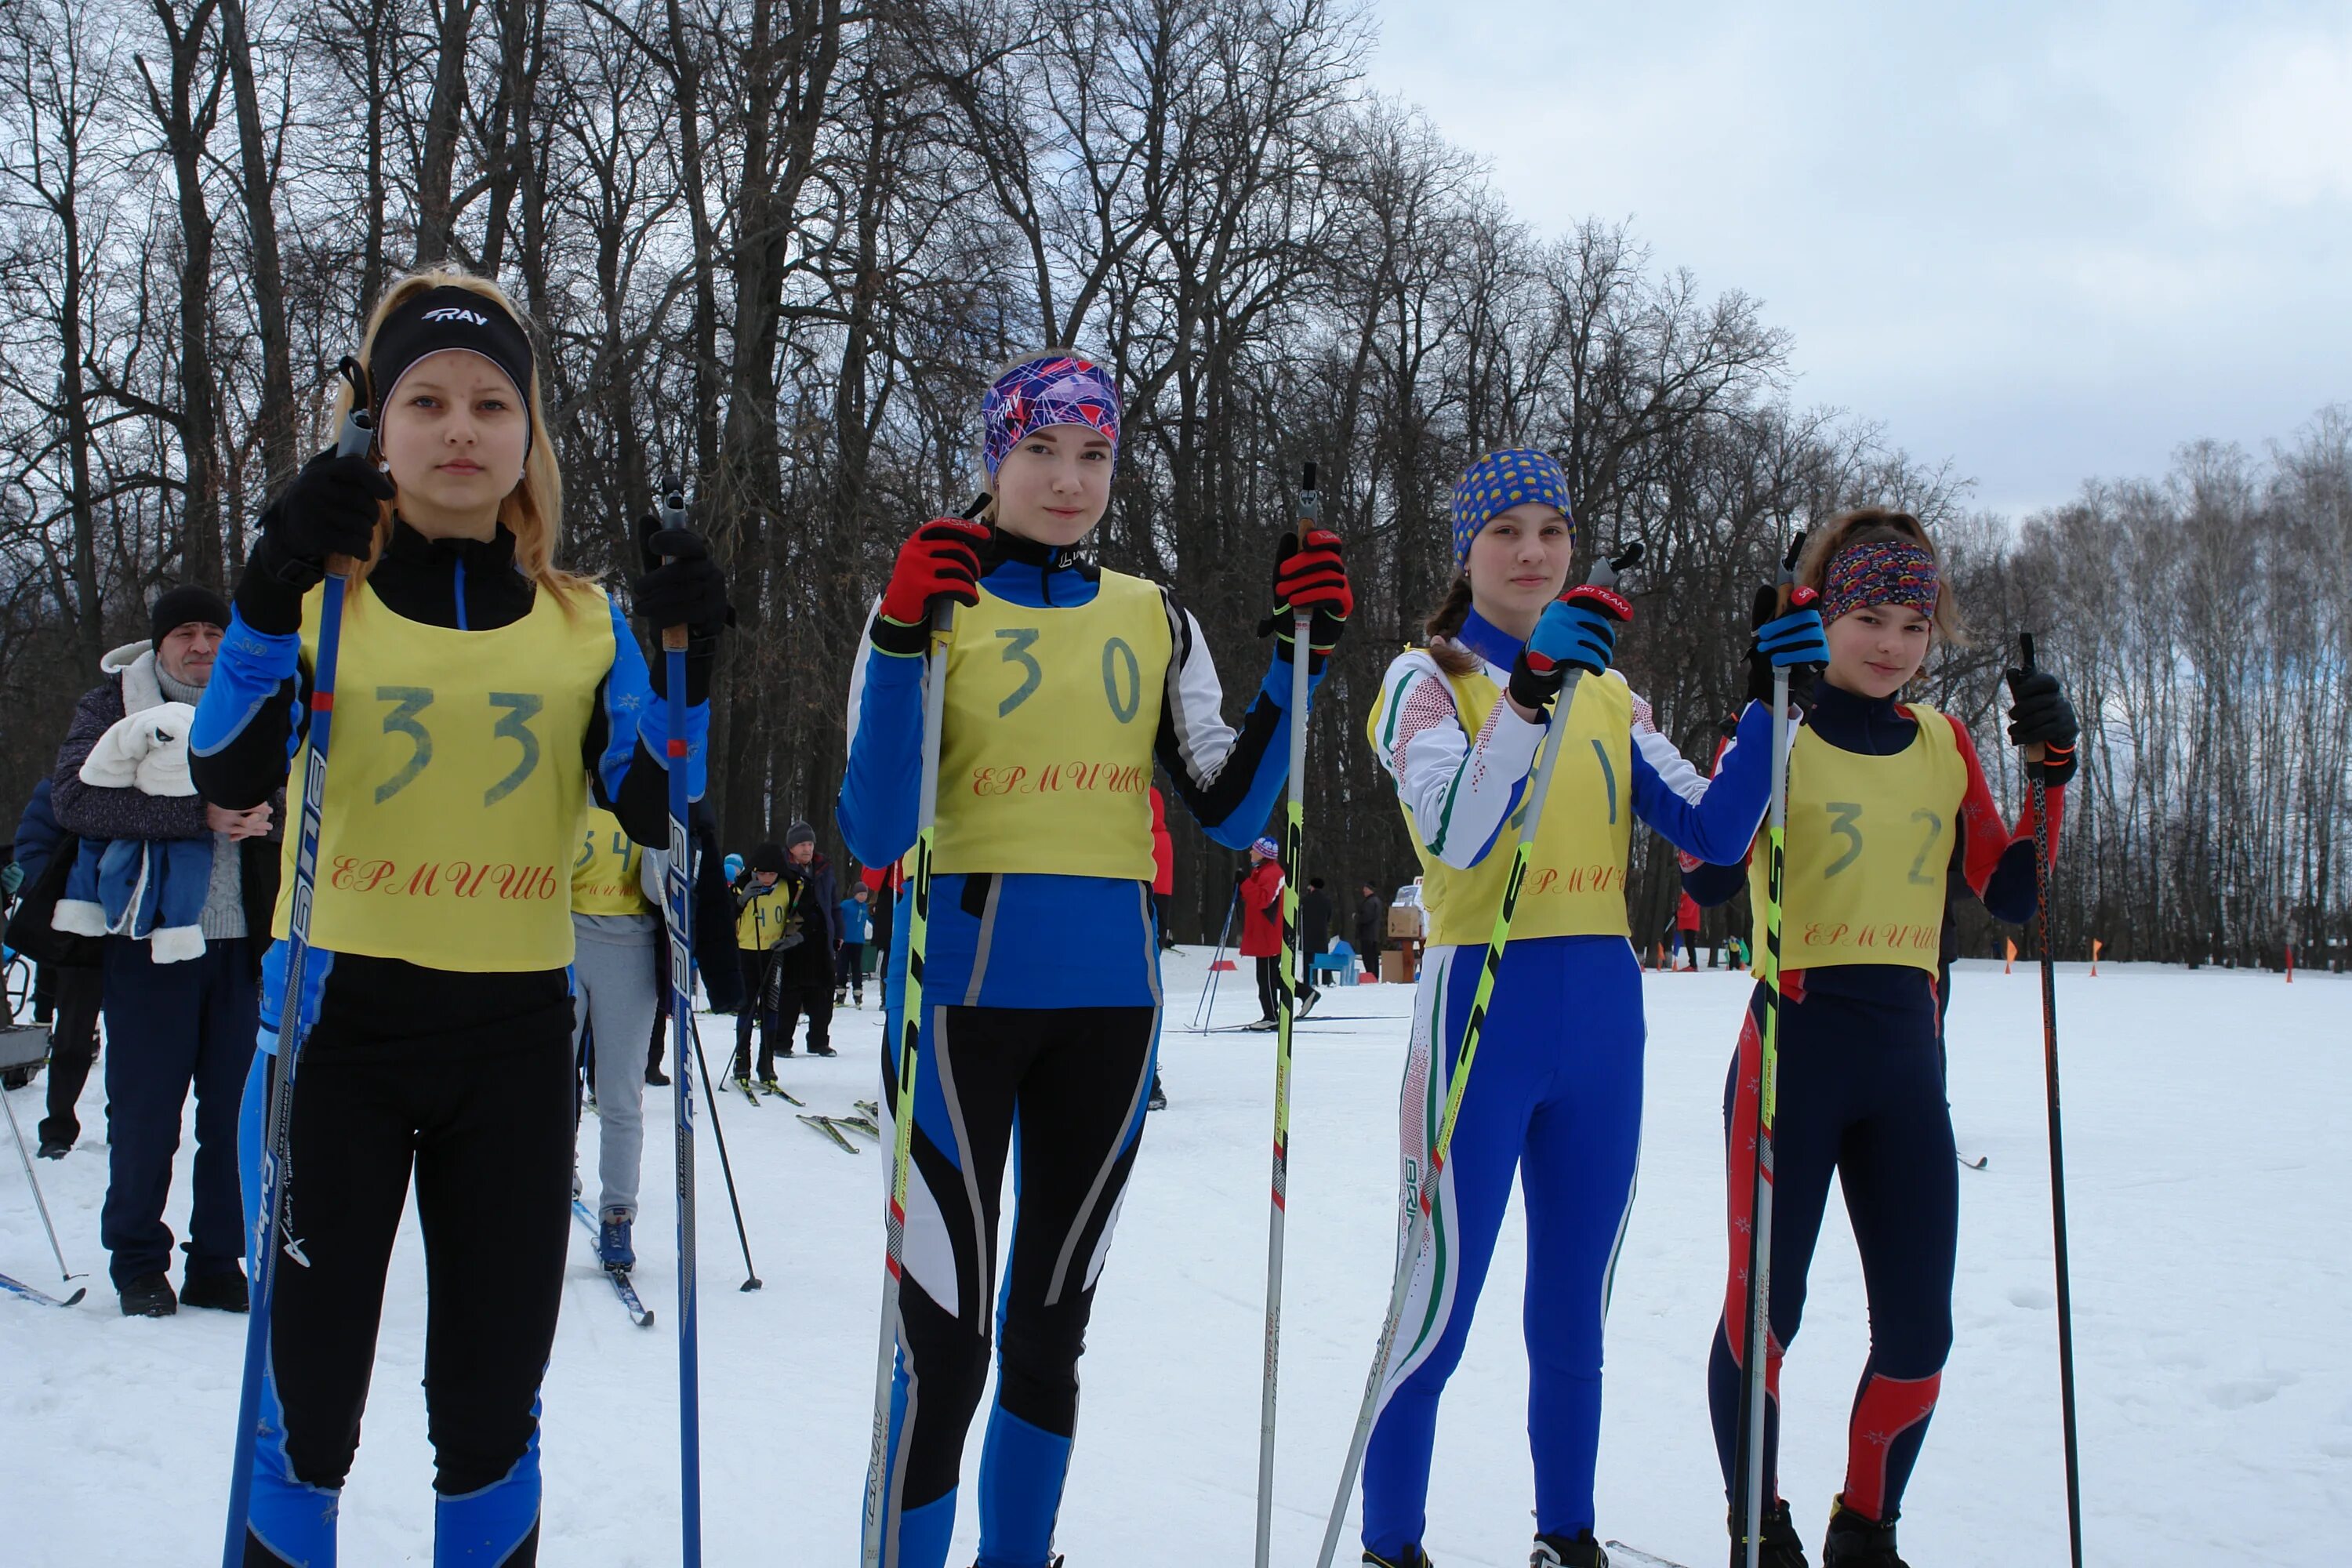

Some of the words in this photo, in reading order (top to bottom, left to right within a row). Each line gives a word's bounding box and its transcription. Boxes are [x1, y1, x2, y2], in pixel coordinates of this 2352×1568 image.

[1598, 590, 1629, 612] TEAM
[995, 628, 1141, 724] 30
[375, 686, 544, 808] 33
[332, 855, 556, 900] ЕРМИШЬ
[1824, 802, 1942, 886] 32
[669, 812, 689, 999] STC
